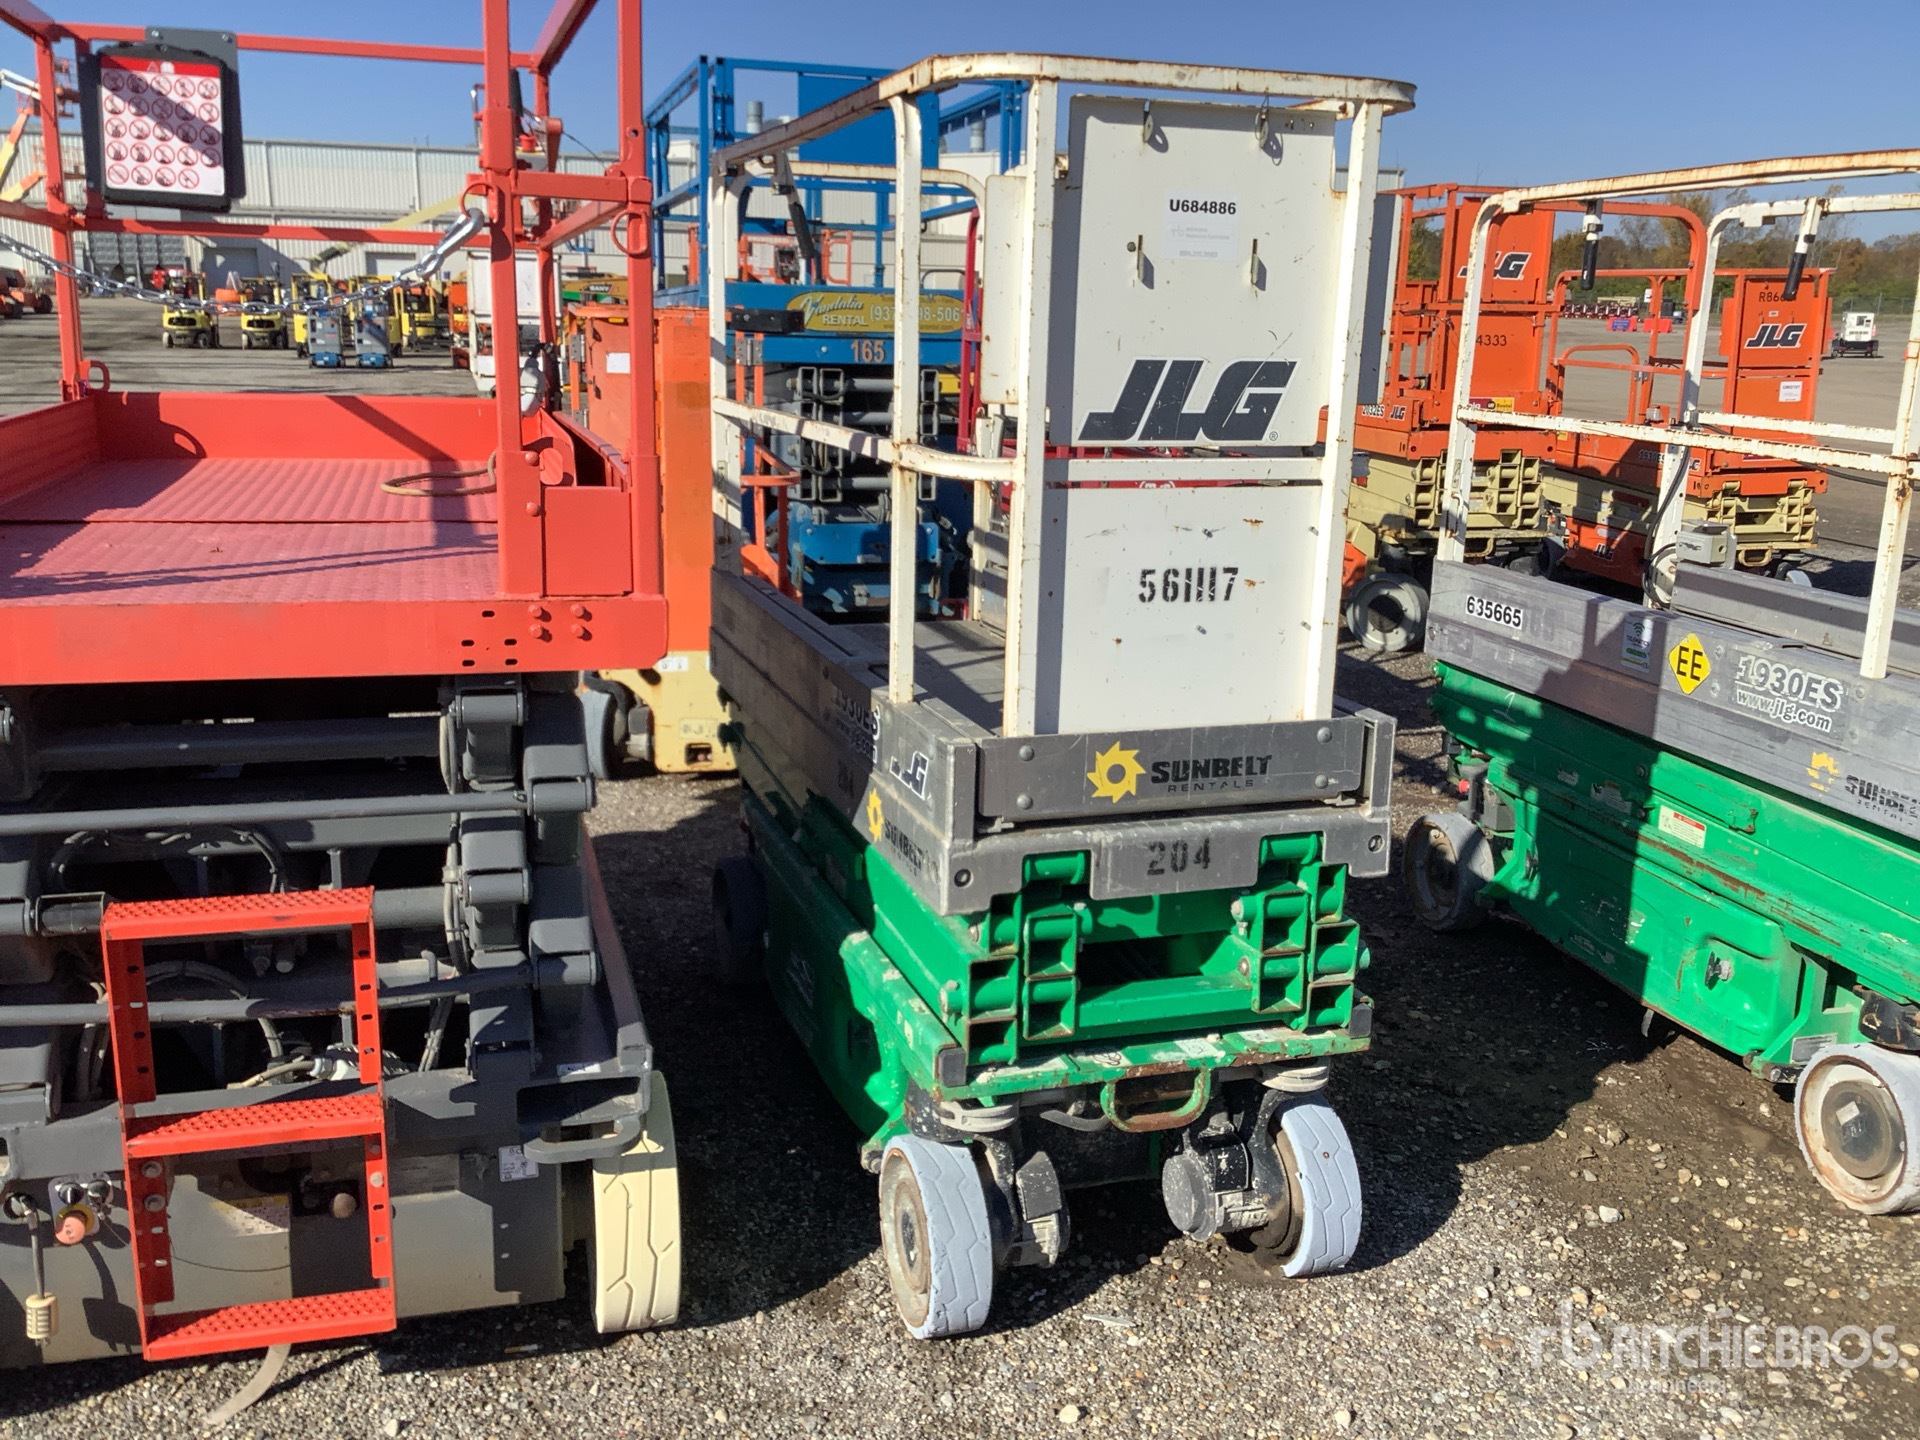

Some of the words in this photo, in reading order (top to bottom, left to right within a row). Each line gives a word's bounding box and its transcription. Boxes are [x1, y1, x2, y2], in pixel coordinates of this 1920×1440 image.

[1169, 199, 1236, 215] U684886
[800, 294, 864, 326] Vandalia
[822, 314, 867, 327] RENTAL
[851, 339, 885, 363] 165
[1744, 323, 1807, 349] JLG
[1078, 359, 1298, 441] JLG
[1390, 405, 1406, 421] JLG
[1139, 567, 1239, 603] 561117
[1466, 596, 1522, 628] 635665
[1676, 645, 1703, 681] EE
[1736, 690, 1833, 733] www.jlg.com
[1151, 754, 1273, 784] SUNBELT
[1167, 779, 1254, 793] RENTALS
[1147, 837, 1211, 876] 204
